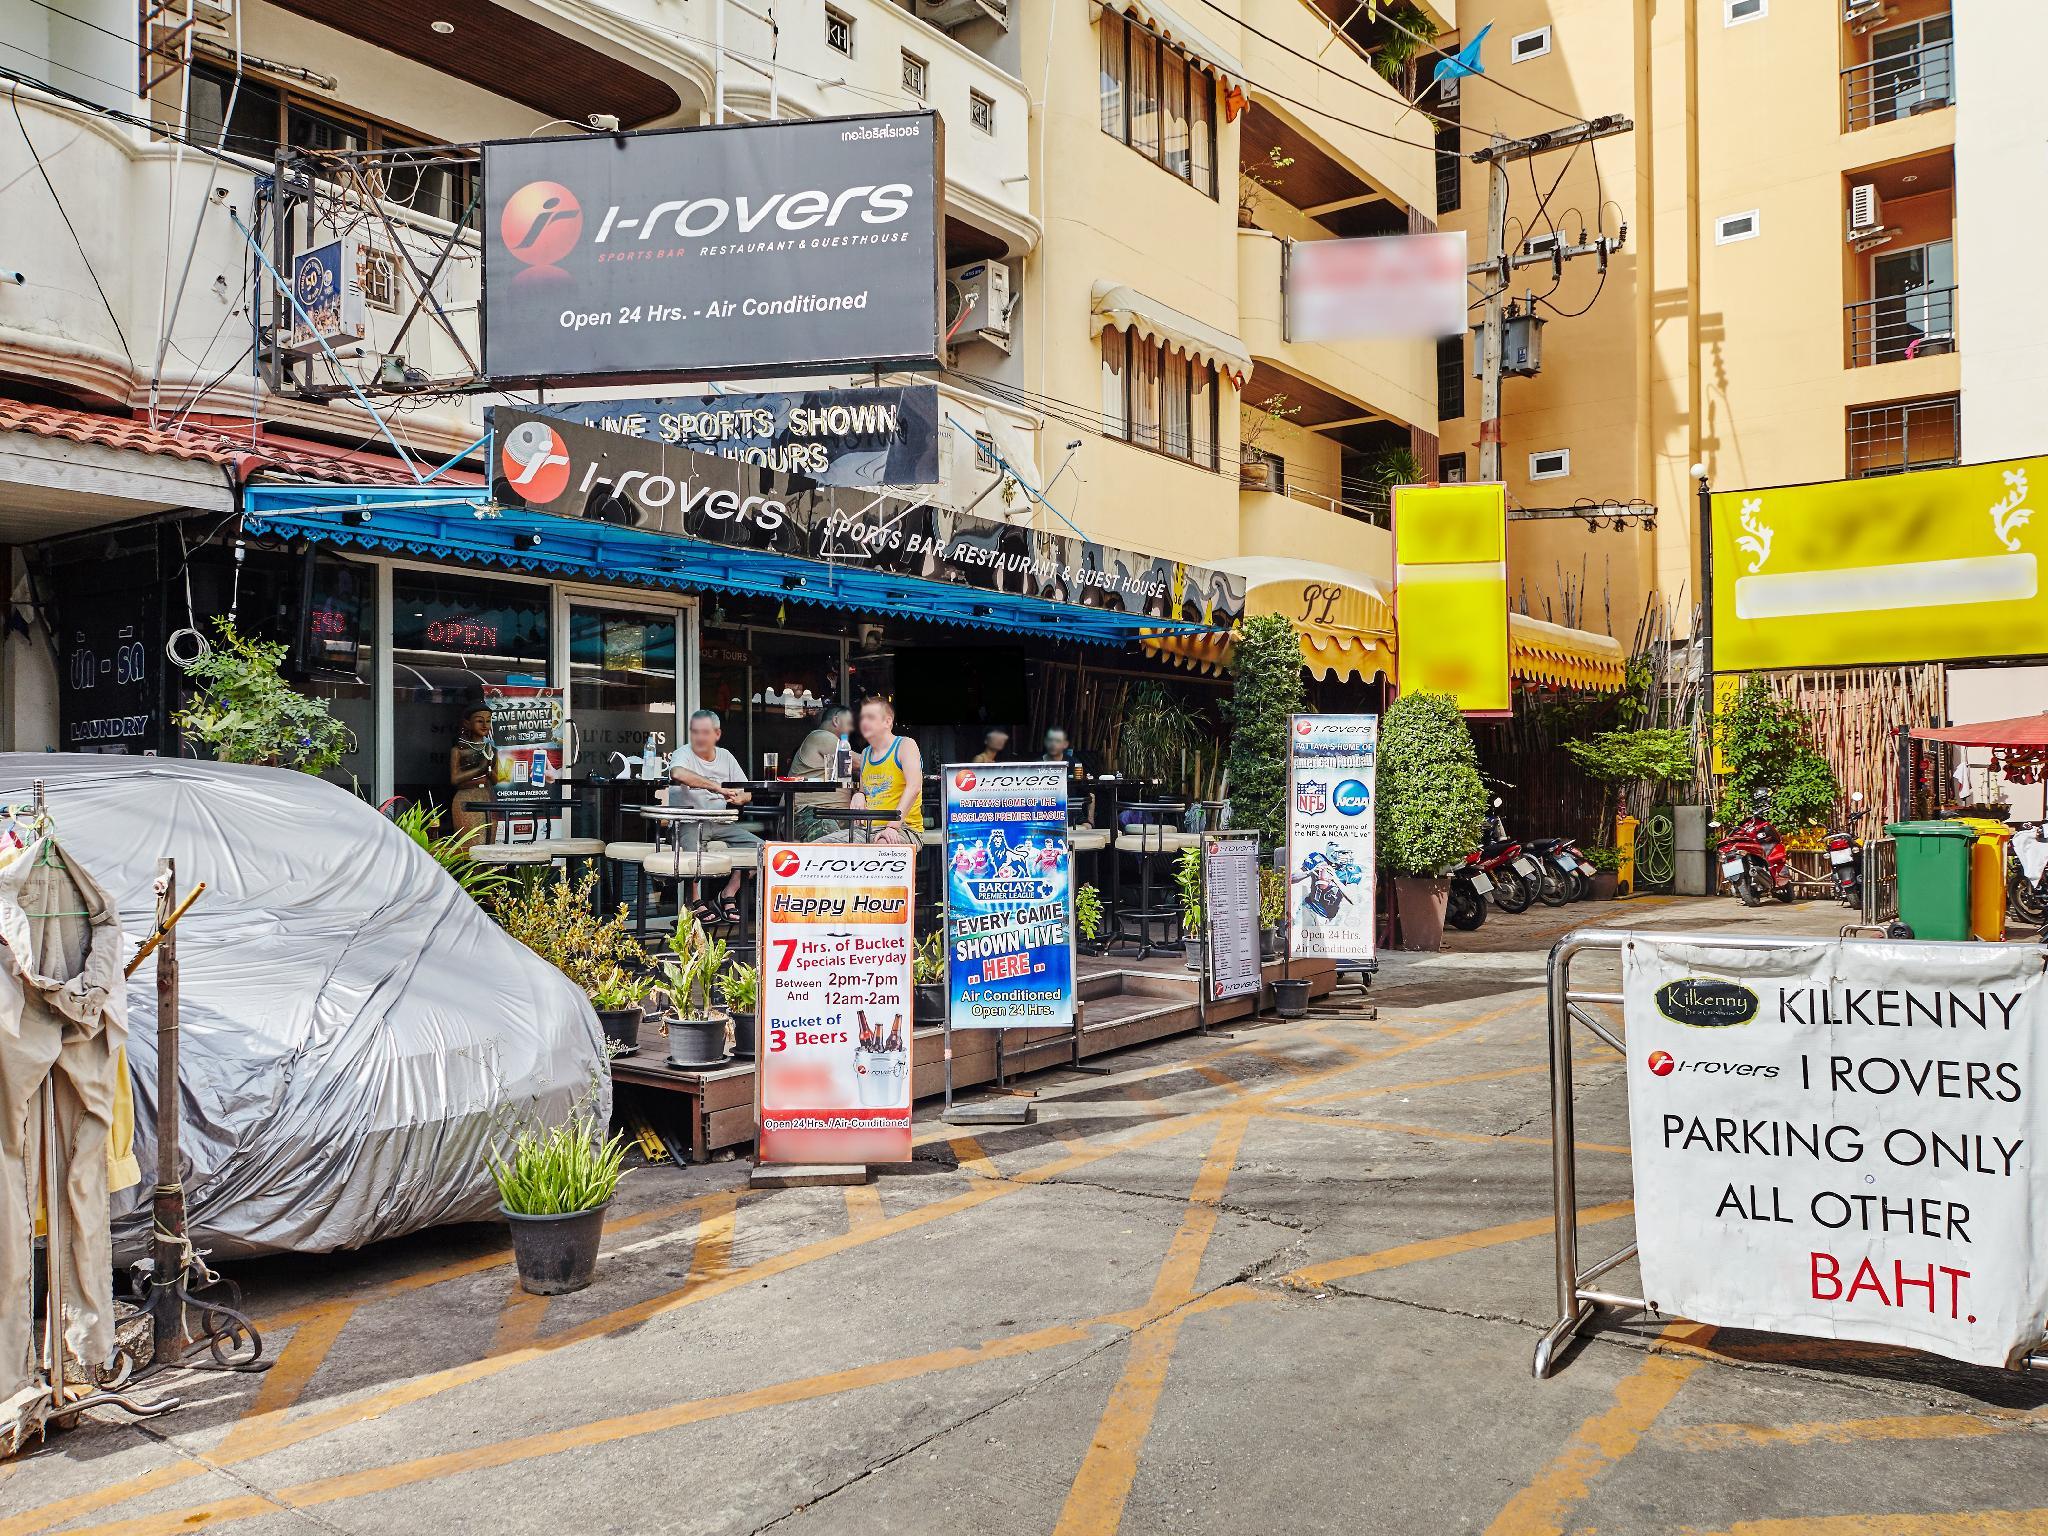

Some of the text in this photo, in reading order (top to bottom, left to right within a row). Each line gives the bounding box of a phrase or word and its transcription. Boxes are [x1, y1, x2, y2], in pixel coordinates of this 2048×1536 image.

[598, 232, 909, 263] SPORTS BAR RESTAURANT & GUESTHOUSE
[560, 310, 612, 330] Open
[619, 308, 641, 324] 24
[648, 304, 688, 322] Hrs.
[706, 301, 737, 319] Air
[742, 291, 867, 315] Conditioned
[659, 409, 775, 442] SPORTS
[790, 404, 897, 437] SHOWN
[824, 517, 902, 550] SPORTS
[906, 533, 948, 560] BAR,
[954, 543, 1058, 577] RESTAURANT
[1061, 567, 1072, 582] &
[1075, 571, 1120, 590] GUEST
[1121, 576, 1166, 599] HOUSE
[428, 621, 497, 646] OPEN
[701, 649, 748, 661] OLF TOURS
[491, 709, 550, 722] SAVE MONEY
[519, 719, 552, 730] MOVIES
[71, 715, 149, 741] LAUNDRY
[1337, 743, 1360, 751] HOME
[1362, 743, 1373, 751] OF
[1001, 798, 1026, 807] HOME
[1027, 797, 1039, 806] OF
[1040, 797, 1056, 806] THE
[1299, 795, 1325, 811] NFL
[1337, 797, 1370, 807] NCAA
[951, 810, 1065, 822] BARCLAYS PREMIER LEAGUE
[1295, 822, 1319, 831] Playing
[978, 882, 1035, 893] BARCLAYS
[773, 894, 905, 917] Happy Hour
[957, 902, 1063, 936] EVERY GAME
[956, 923, 1064, 961] SHOWN LIVE
[1301, 929, 1361, 941] Open 24 Hrs.
[773, 937, 905, 972] 7 Hrs. of Bucket
[1295, 943, 1367, 954] Air Conditioned
[796, 952, 907, 971] Specials Everyday
[982, 952, 1031, 982] HERE
[776, 972, 898, 988] Between 2pm-7pm
[787, 991, 900, 1005] And 12am-2am
[961, 988, 1061, 1002] Air Conditioned
[1668, 986, 1747, 1015] Kilkenny
[972, 1004, 1054, 1018] Open 24 Hrs.
[1779, 987, 2021, 1030] KILKENNY
[771, 1014, 842, 1029] Bucket of
[770, 1029, 848, 1053] 3 Beers
[1801, 1055, 2022, 1103] I ROVERS
[765, 1119, 793, 1131] Open
[794, 1118, 806, 1129] 24
[808, 1117, 828, 1129] Hrs.
[835, 1117, 909, 1129] Air-Conditioned
[1663, 1114, 2024, 1177] PARKING ONLY
[1715, 1183, 1972, 1243] ALL OTHER
[1811, 1252, 1977, 1324] BAHT.
